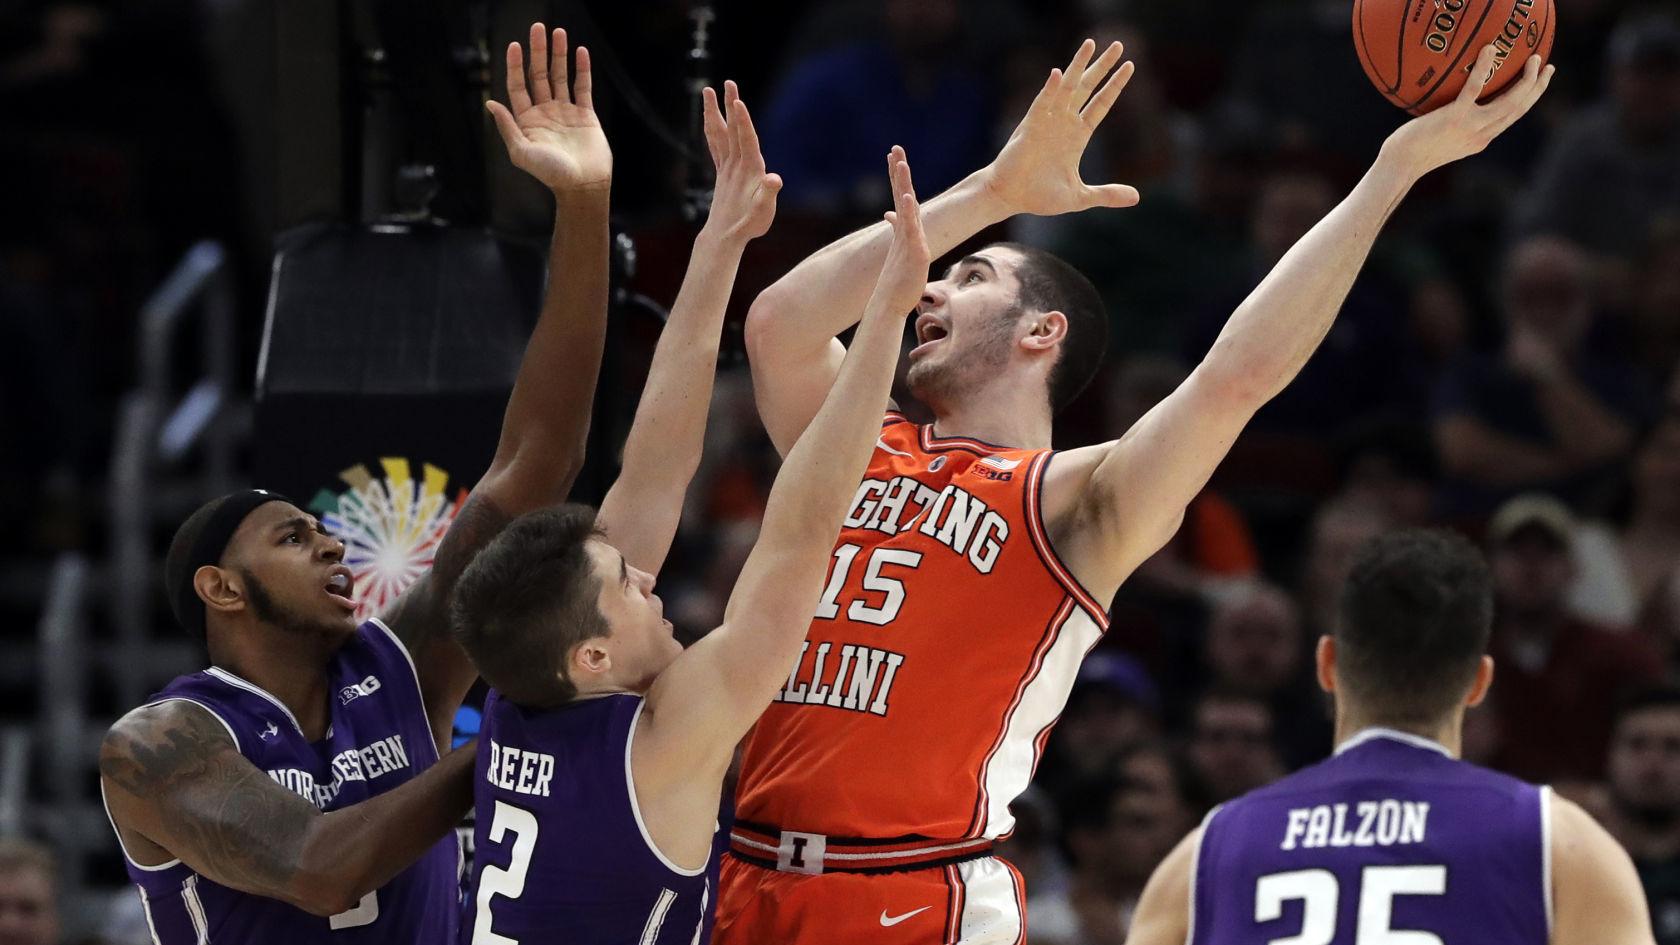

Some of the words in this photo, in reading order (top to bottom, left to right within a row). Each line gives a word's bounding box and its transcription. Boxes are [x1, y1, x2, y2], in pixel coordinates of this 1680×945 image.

[1426, 0, 1465, 53] 000
[843, 476, 1009, 574] GHTING
[814, 543, 924, 626] 15
[774, 640, 905, 716] LLINI
[267, 735, 410, 809] NORHESERN
[1281, 799, 1431, 850] FALZON
[471, 800, 538, 945] 2
